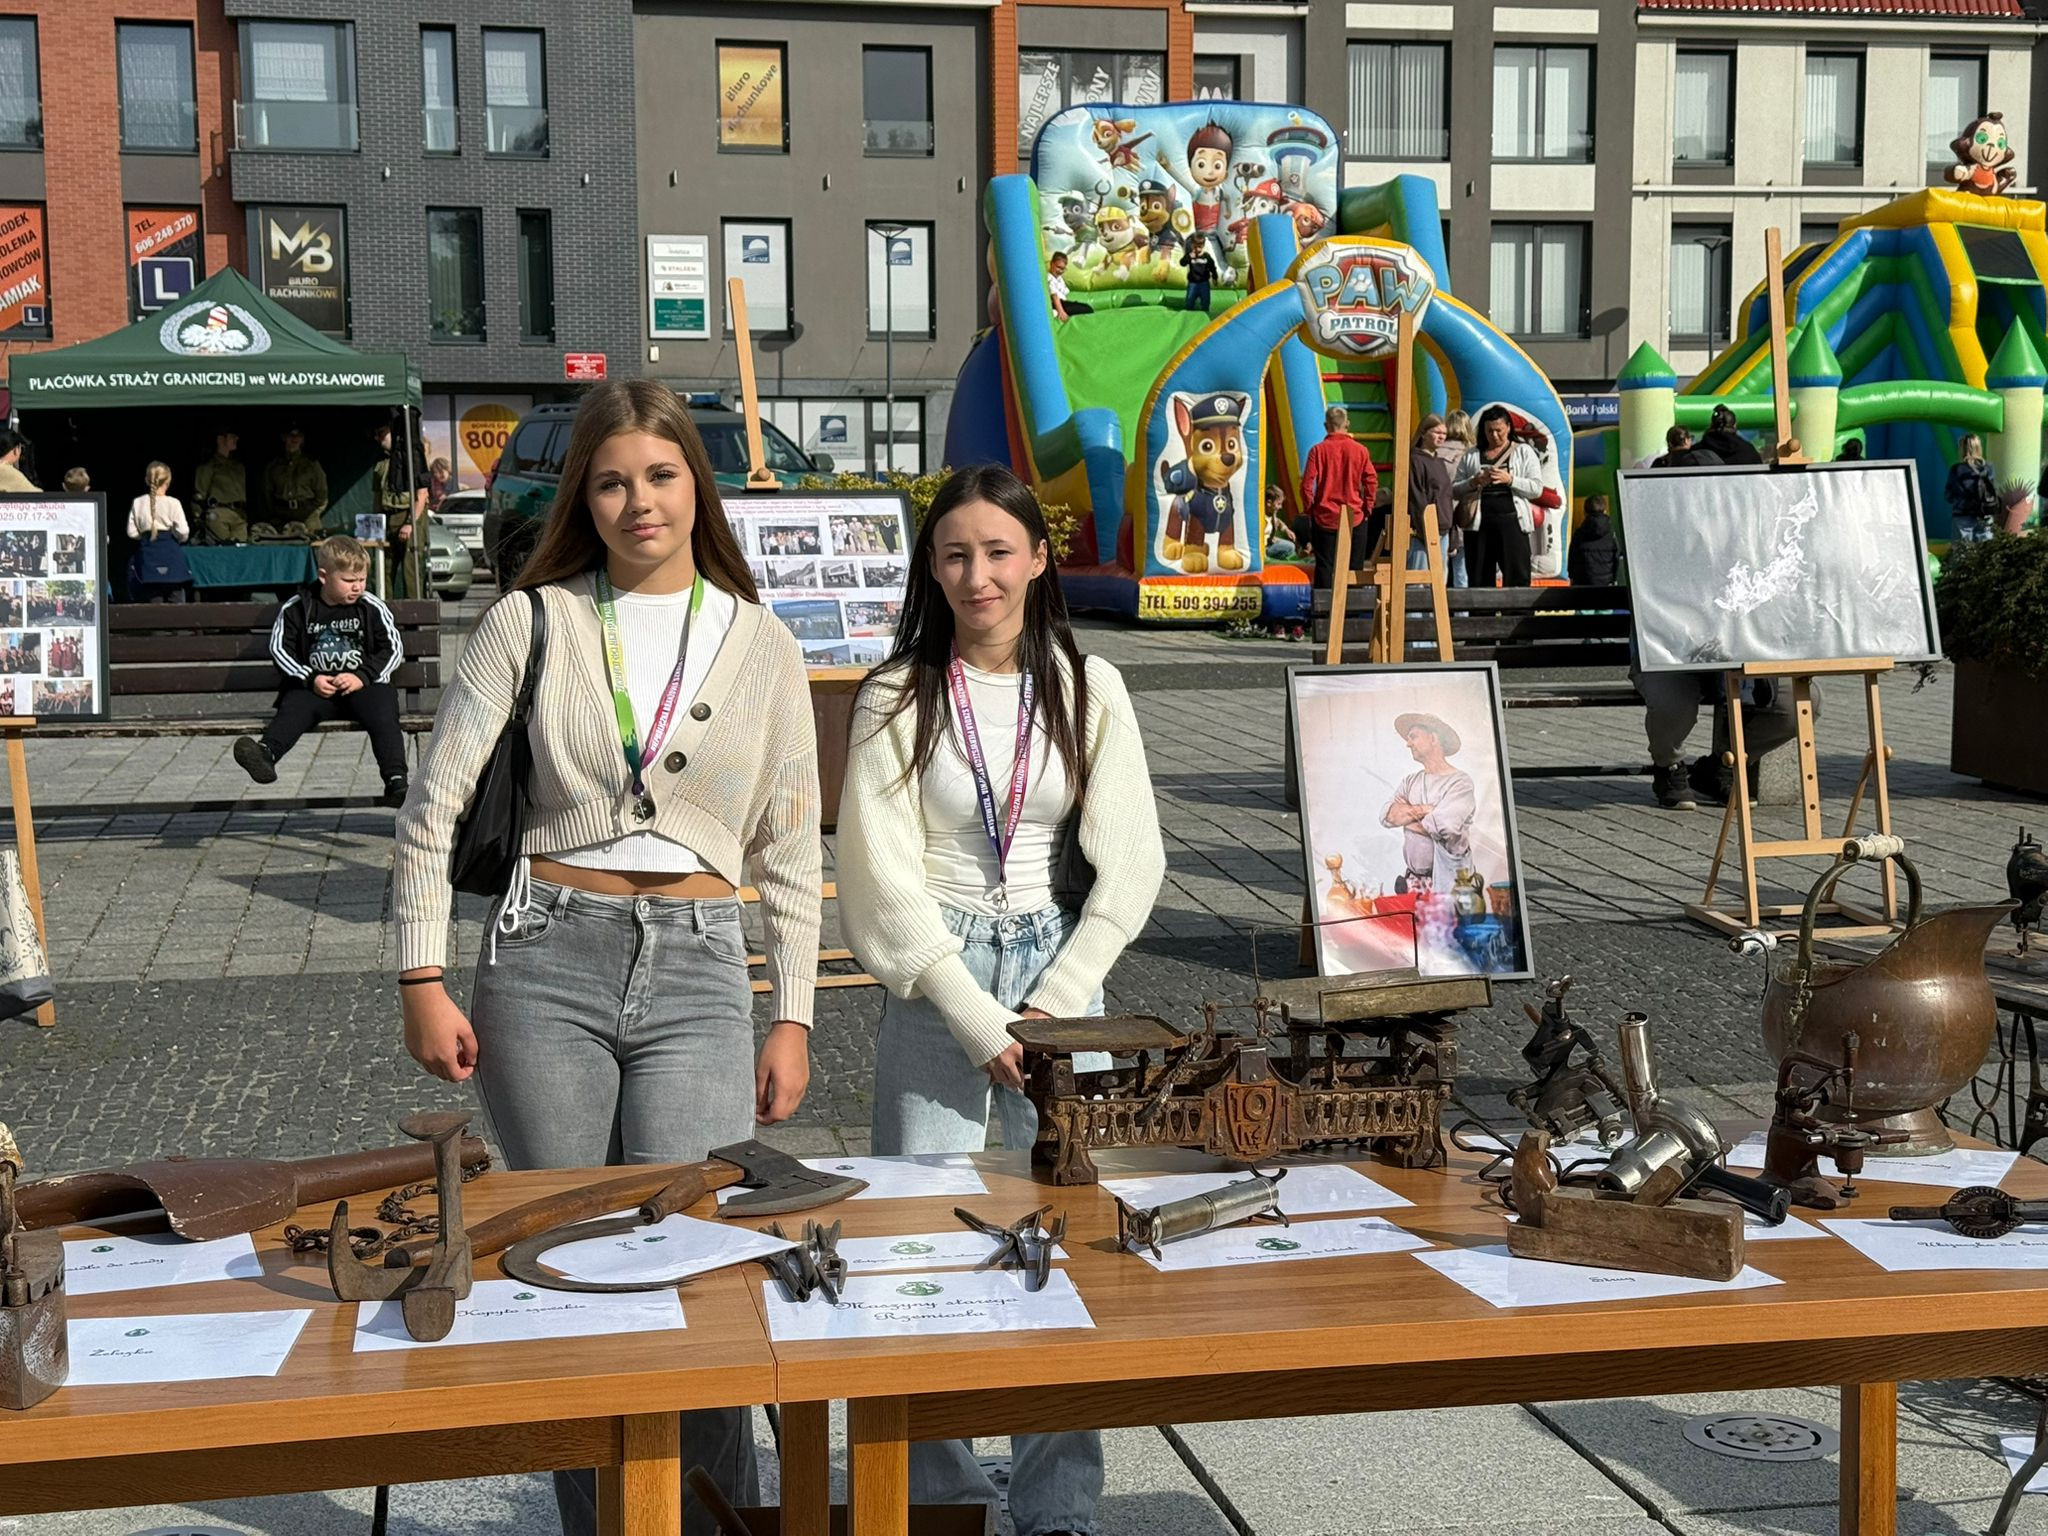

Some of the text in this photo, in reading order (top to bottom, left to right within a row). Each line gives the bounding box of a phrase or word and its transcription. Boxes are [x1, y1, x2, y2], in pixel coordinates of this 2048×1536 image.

[725, 71, 751, 102] Biuro
[1021, 61, 1060, 139] NAJLEPSZE
[0, 211, 29, 238] ODEK
[135, 214, 193, 254] 606 248 370
[0, 229, 37, 260] OLENIA
[270, 218, 334, 273] MB
[0, 247, 41, 281] OWCÓW
[0, 274, 42, 313] AMIAK
[155, 268, 180, 300] L
[269, 287, 338, 299] RACHUNKOWE
[288, 277, 319, 286] BIURO
[1305, 264, 1432, 313] PAW
[1329, 316, 1398, 336] PATROL
[29, 371, 386, 390] PLACÓWKA STRAŻY GRANICZNEJ we WŁADYSŁAWOWIE
[1566, 403, 1618, 416] Bank Polski
[1145, 595, 1258, 611] TEL. 509 394 255
[331, 617, 361, 632] CLOSED
[309, 650, 363, 671] AWS
[1229, 1088, 1274, 1122] 10
